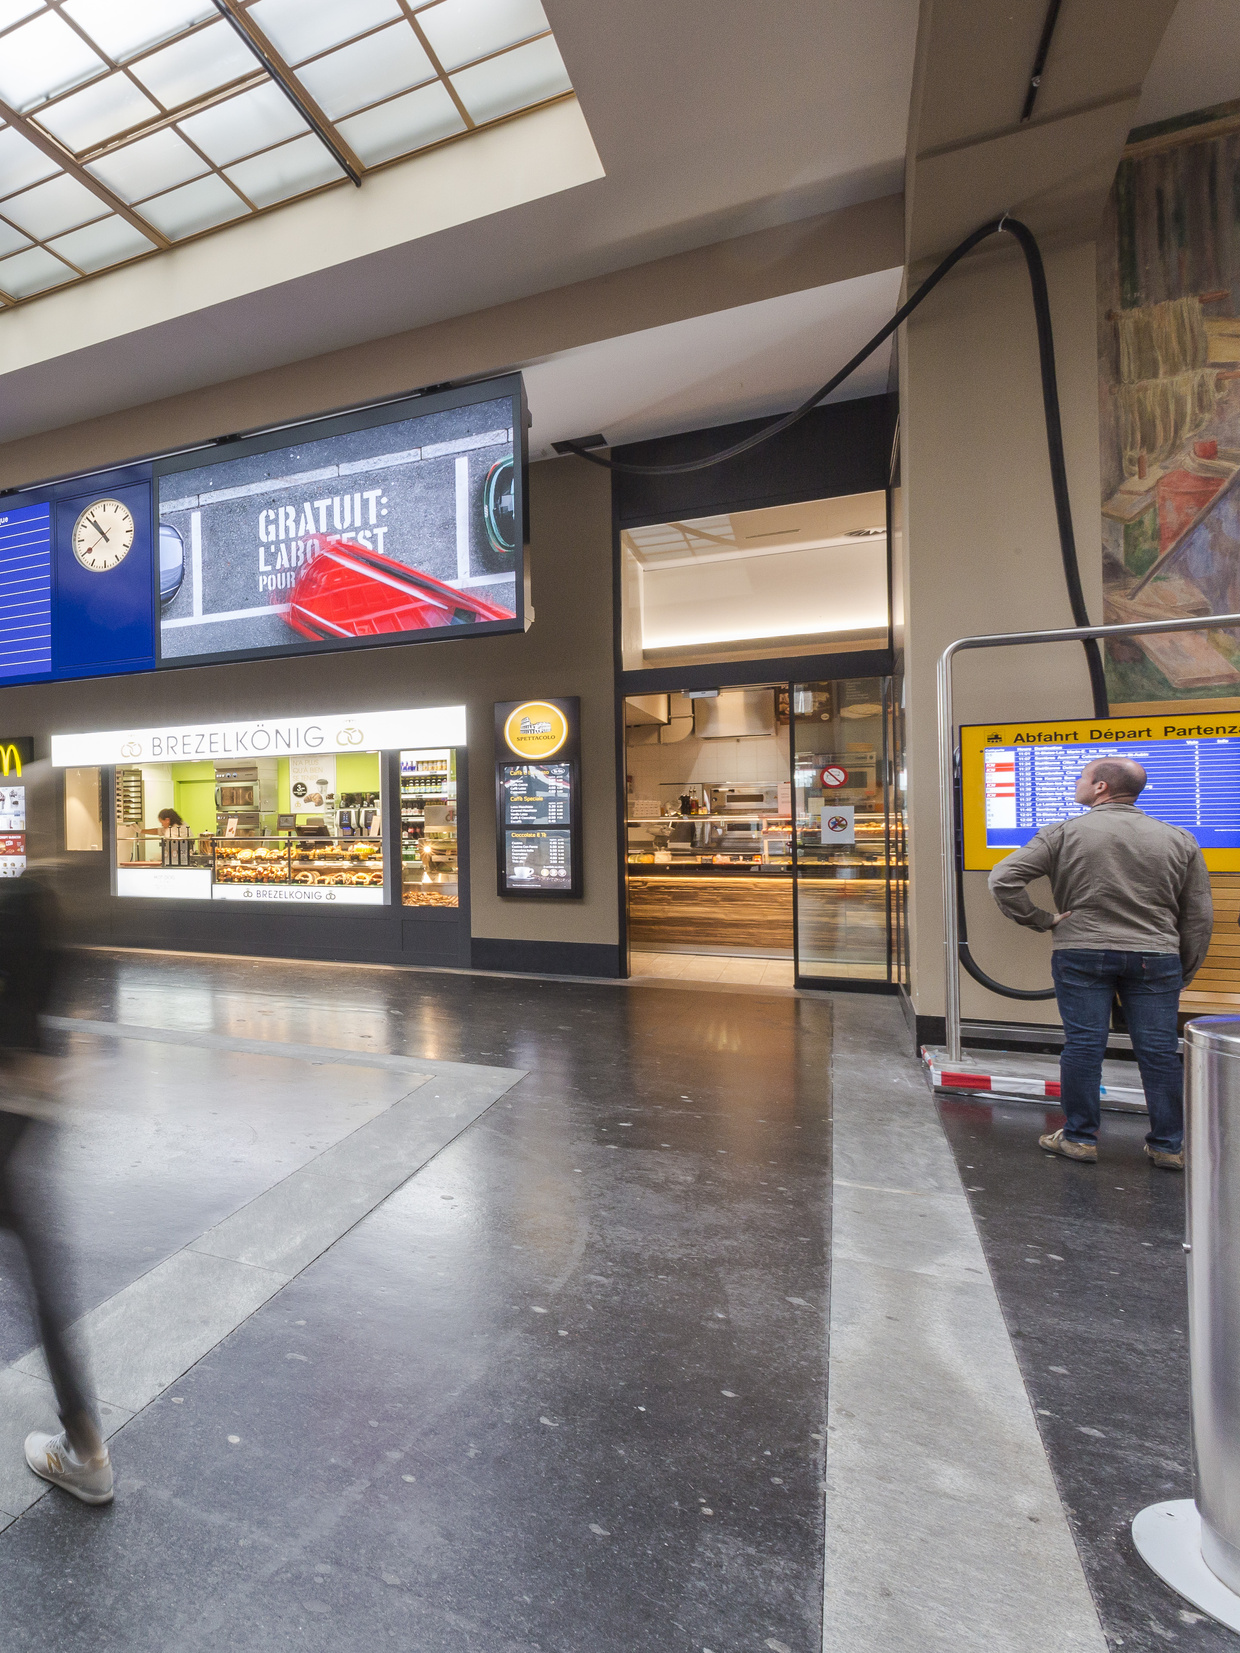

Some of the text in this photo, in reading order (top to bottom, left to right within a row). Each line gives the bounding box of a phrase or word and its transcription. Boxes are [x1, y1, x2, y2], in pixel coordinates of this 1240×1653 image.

[259, 489, 388, 543] GRATUIT:
[259, 538, 320, 571] L'ABO
[259, 572, 295, 592] POUR
[152, 724, 324, 756] BREZELKÖNIG
[1013, 725, 1240, 743] Abfahrt Départ Partenz
[256, 889, 322, 900] BREZELKÖNIG
